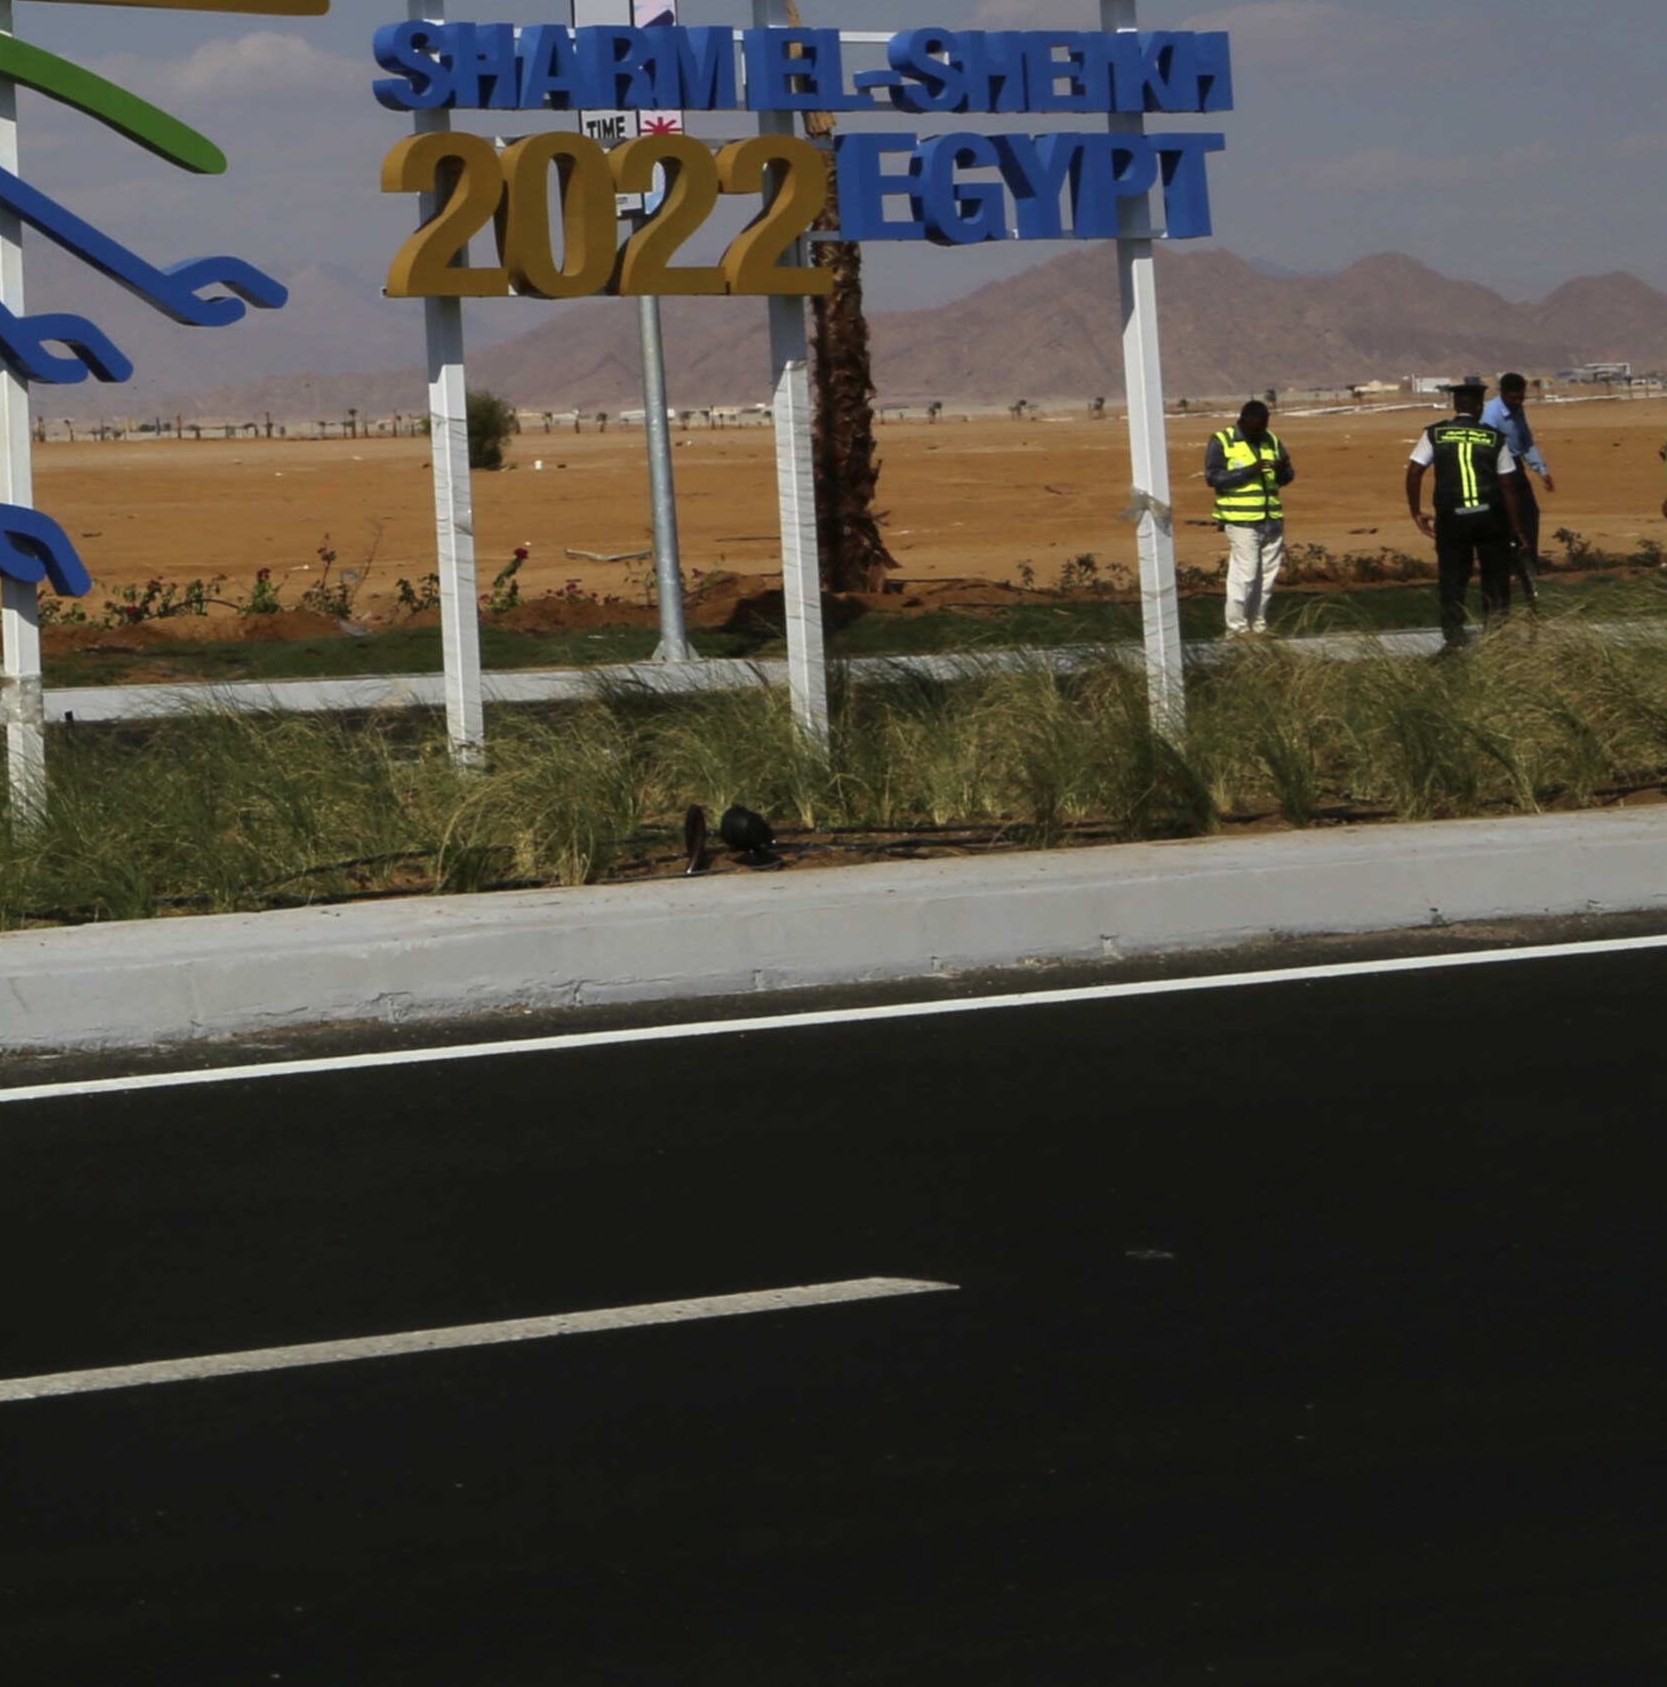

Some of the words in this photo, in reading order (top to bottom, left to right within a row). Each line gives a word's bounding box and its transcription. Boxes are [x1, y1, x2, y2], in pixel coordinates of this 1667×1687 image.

[372, 20, 737, 111] SHARM
[744, 27, 1234, 113] EL-SHEIKH
[586, 115, 627, 140] TIME
[381, 131, 834, 298] 2022
[835, 132, 1226, 246] EGYPT
